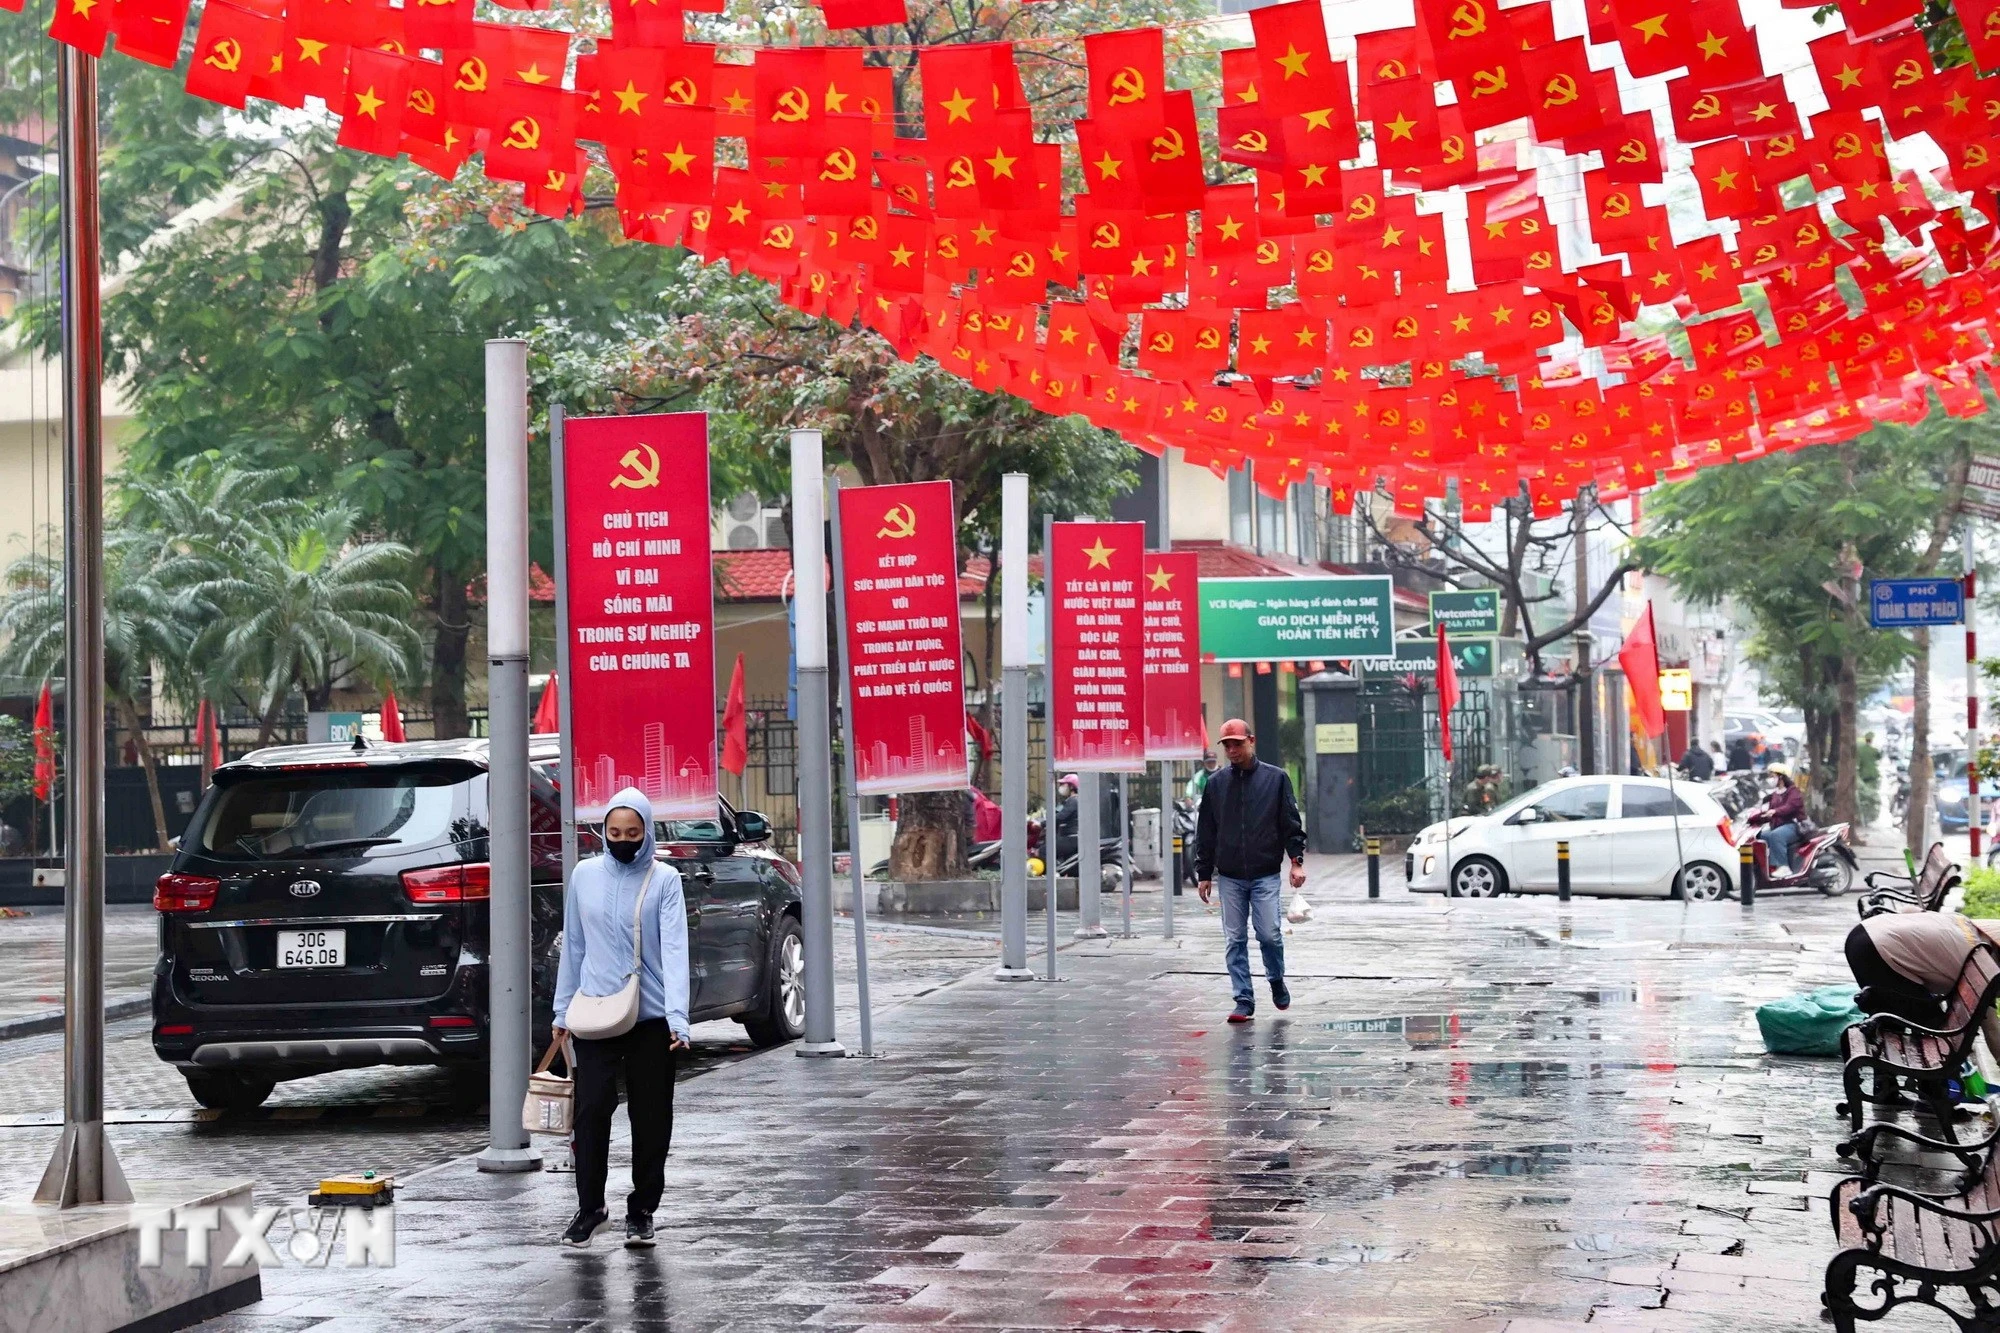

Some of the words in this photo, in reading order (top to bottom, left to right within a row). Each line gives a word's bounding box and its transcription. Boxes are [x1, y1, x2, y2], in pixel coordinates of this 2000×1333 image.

[603, 509, 632, 529] CHỦ
[636, 511, 669, 530] TỊCH
[592, 537, 612, 558] HỒ
[616, 538, 640, 557] CHÍ
[644, 539, 681, 556] MINH
[878, 553, 896, 568] KẾT
[897, 553, 917, 568] HỢP
[616, 567, 631, 585] VĨ
[634, 568, 659, 587] ĐẠI
[853, 578, 874, 591] SỨC
[875, 577, 903, 591] MẠNH
[904, 574, 924, 587] DÂN
[925, 573, 945, 587] TỘC
[1065, 578, 1083, 592] TẤT
[1085, 579, 1098, 592] CẢ
[1099, 580, 1110, 592] VÌ
[1112, 580, 1133, 593] MỘT
[1908, 584, 1937, 596] PHỐ
[604, 593, 642, 614] SỐNG
[646, 594, 673, 612] MÃI
[891, 596, 909, 609] VỚI
[1063, 597, 1090, 609] NƯỚC
[1091, 597, 1112, 610] VIỆT
[1113, 597, 1136, 609] NAM
[1208, 599, 1227, 609] VCB
[1342, 597, 1358, 607] cho
[1359, 596, 1379, 607] SME
[1076, 613, 1096, 625] HÒA
[1097, 613, 1123, 625] BÌNH,
[1258, 615, 1287, 626] GIAO
[1290, 615, 1319, 628] DỊCH
[1321, 610, 1351, 625] MIỄN
[1354, 611, 1379, 627] PHÍ,
[1434, 607, 1495, 619] Vietcombank
[856, 620, 876, 633] SỨC
[877, 619, 905, 633] MẠNH
[906, 616, 929, 630] THỜI
[931, 616, 948, 630] ĐẠI
[1464, 620, 1485, 628] ATM
[577, 626, 624, 643] TRONG
[627, 623, 648, 644] SỰ
[650, 621, 701, 642] NGHIỆP
[1080, 630, 1100, 644] ĐỘC
[1101, 630, 1119, 644] LẬP,
[1277, 626, 1311, 640] HOÀN
[1315, 625, 1341, 640] TIỀN
[1344, 625, 1368, 639] HẾT
[1371, 624, 1380, 639] Ý
[862, 642, 894, 654] TRONG
[895, 639, 914, 652] XÂY
[915, 638, 944, 652] DỰNG,
[1078, 648, 1097, 660] DÂN
[1099, 647, 1121, 660] CHỦ,
[589, 652, 619, 671] CỦA
[622, 652, 670, 670] CHÚNG
[673, 652, 691, 668] TA
[853, 663, 878, 676] PHÁT
[879, 659, 907, 674] TRIỂN
[908, 658, 927, 673] ĐẤT
[928, 658, 955, 671] NƯỚC
[1362, 656, 1464, 672] Vietcombk
[1073, 665, 1095, 677] GIÀU
[1097, 666, 1127, 679] MẠNH,
[858, 684, 872, 697] VÀ
[873, 683, 893, 697] BẢO
[894, 682, 907, 696] VỆ
[908, 680, 921, 694] TỔ
[922, 678, 952, 694] QUỐC!
[1101, 684, 1126, 695] VINH,
[1076, 700, 1095, 712] VĂN
[1097, 701, 1124, 713] MINH,
[1072, 718, 1098, 731] HẠNH
[1100, 718, 1129, 730] PHÚC!
[331, 724, 351, 742] BIDV
[293, 883, 316, 894] KIA
[297, 932, 326, 948] 30G
[285, 949, 338, 966] 646.08
[189, 974, 230, 982] SEDONA
